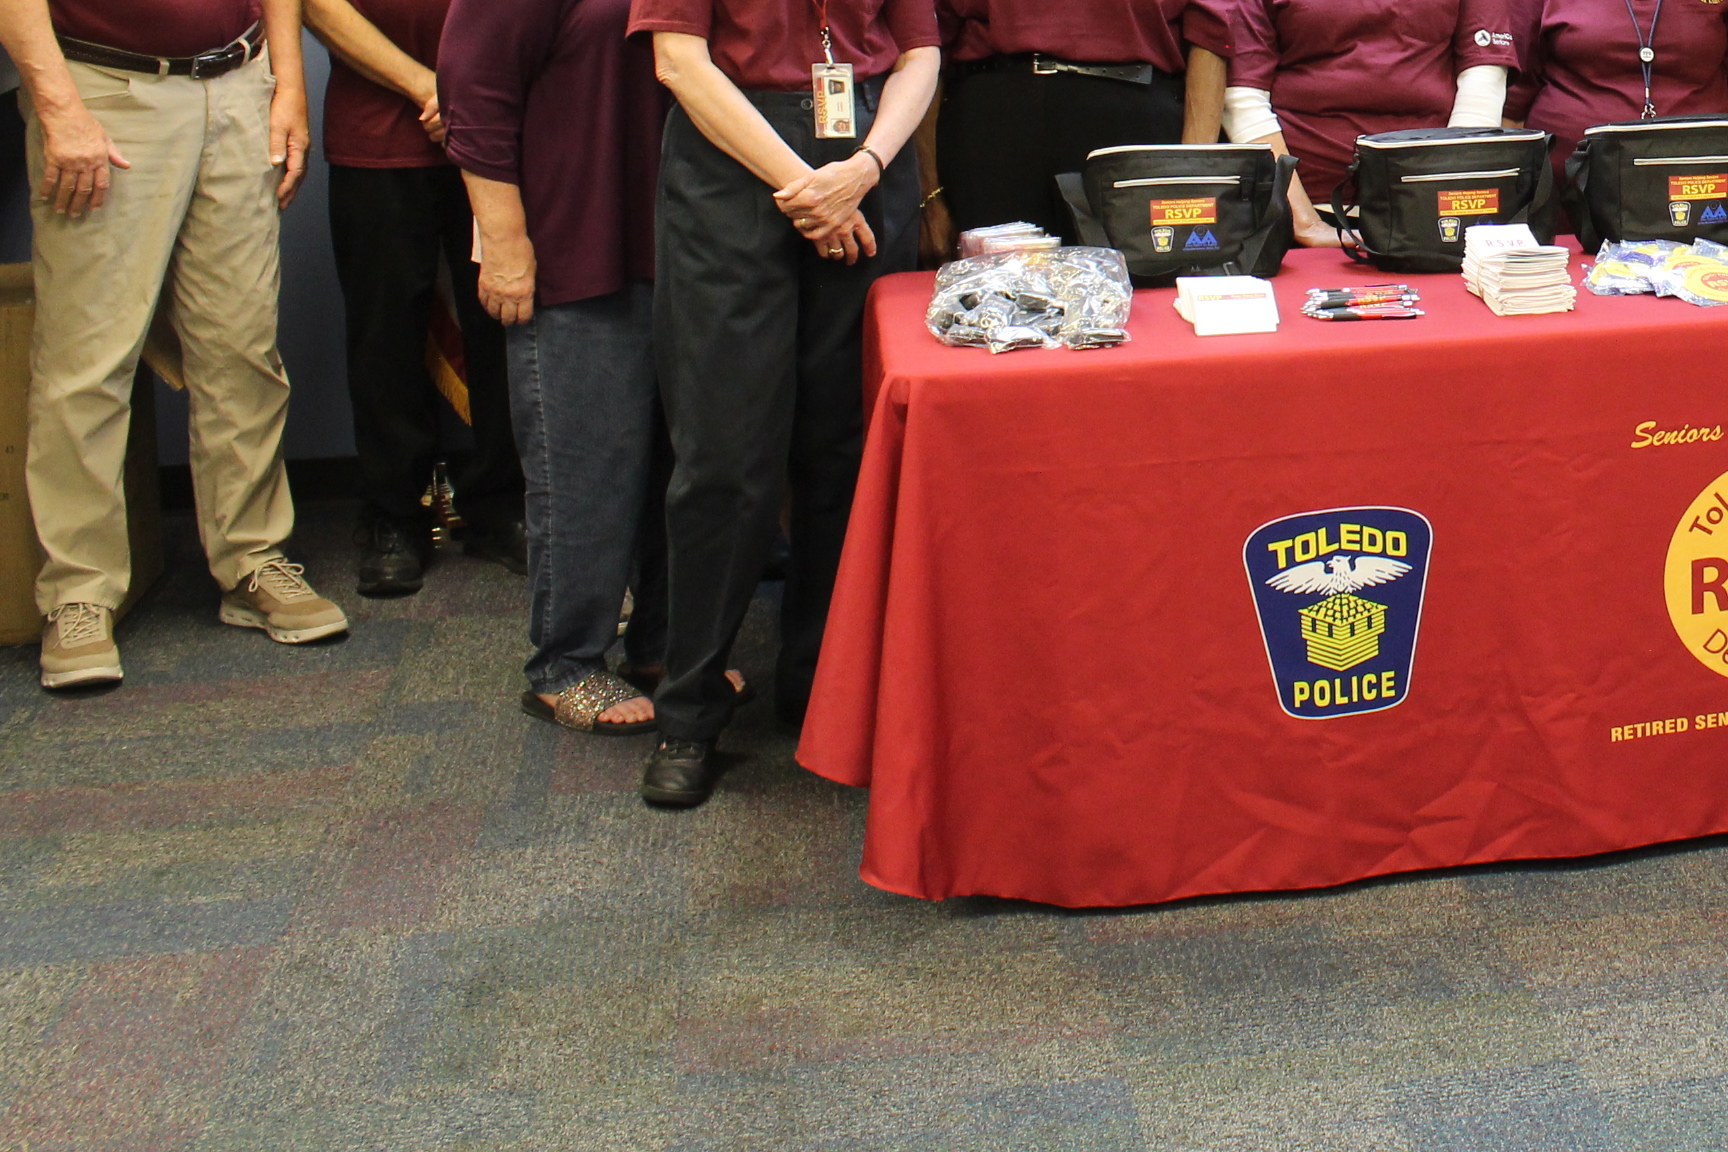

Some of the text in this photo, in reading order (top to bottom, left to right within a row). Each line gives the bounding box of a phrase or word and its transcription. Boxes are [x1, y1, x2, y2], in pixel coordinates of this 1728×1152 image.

[817, 90, 828, 124] RSVP
[1682, 183, 1716, 195] RSVP
[1164, 208, 1202, 219] RSVP
[1451, 199, 1486, 210] RSVP
[1630, 420, 1724, 449] Seniors
[1267, 523, 1408, 570] TOLEDO
[1293, 670, 1397, 708] POLICE
[1610, 716, 1689, 743] RETIRED
